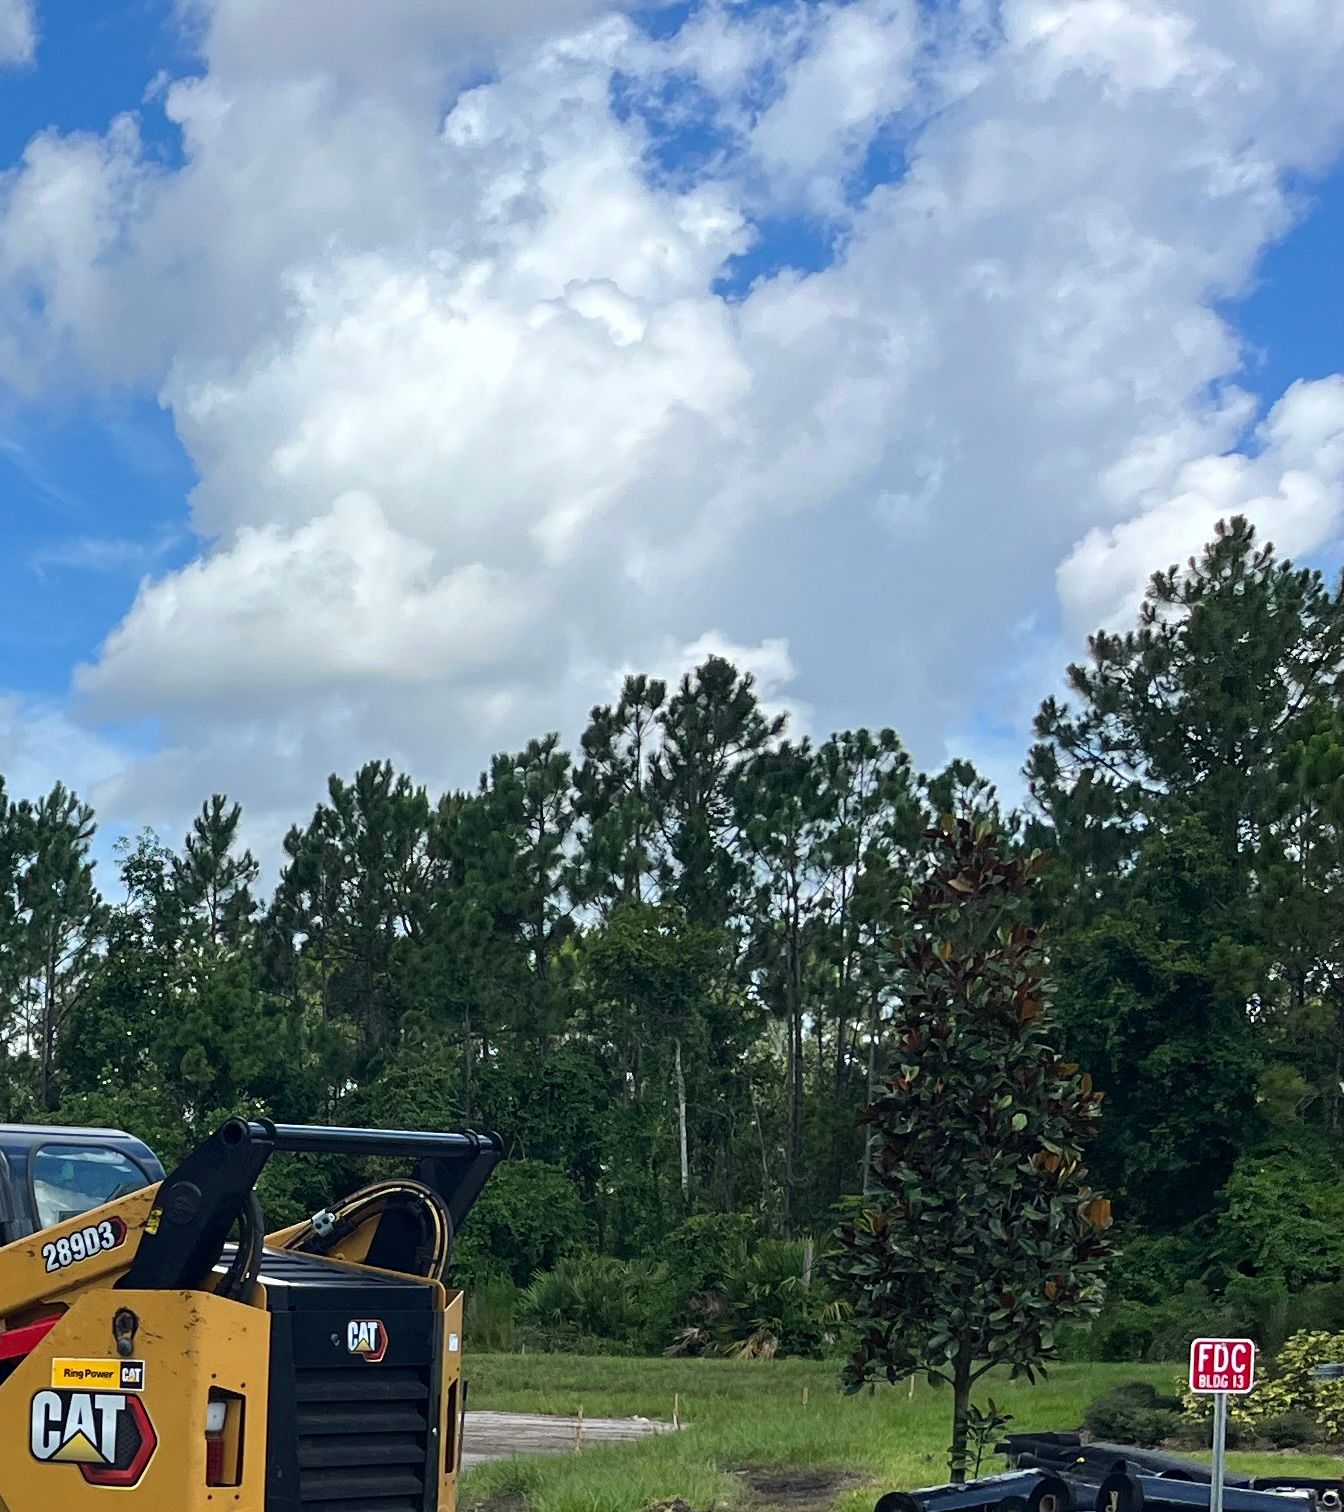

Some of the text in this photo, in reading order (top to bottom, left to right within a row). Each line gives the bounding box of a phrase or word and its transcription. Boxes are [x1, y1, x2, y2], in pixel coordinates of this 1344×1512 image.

[42, 1220, 116, 1273] 289D3
[347, 1321, 378, 1352] CAT
[1198, 1343, 1247, 1373] FDC
[63, 1367, 142, 1383] Ring Power CAT
[1198, 1374, 1245, 1389] BLDG 13
[31, 1390, 127, 1464] CAT
